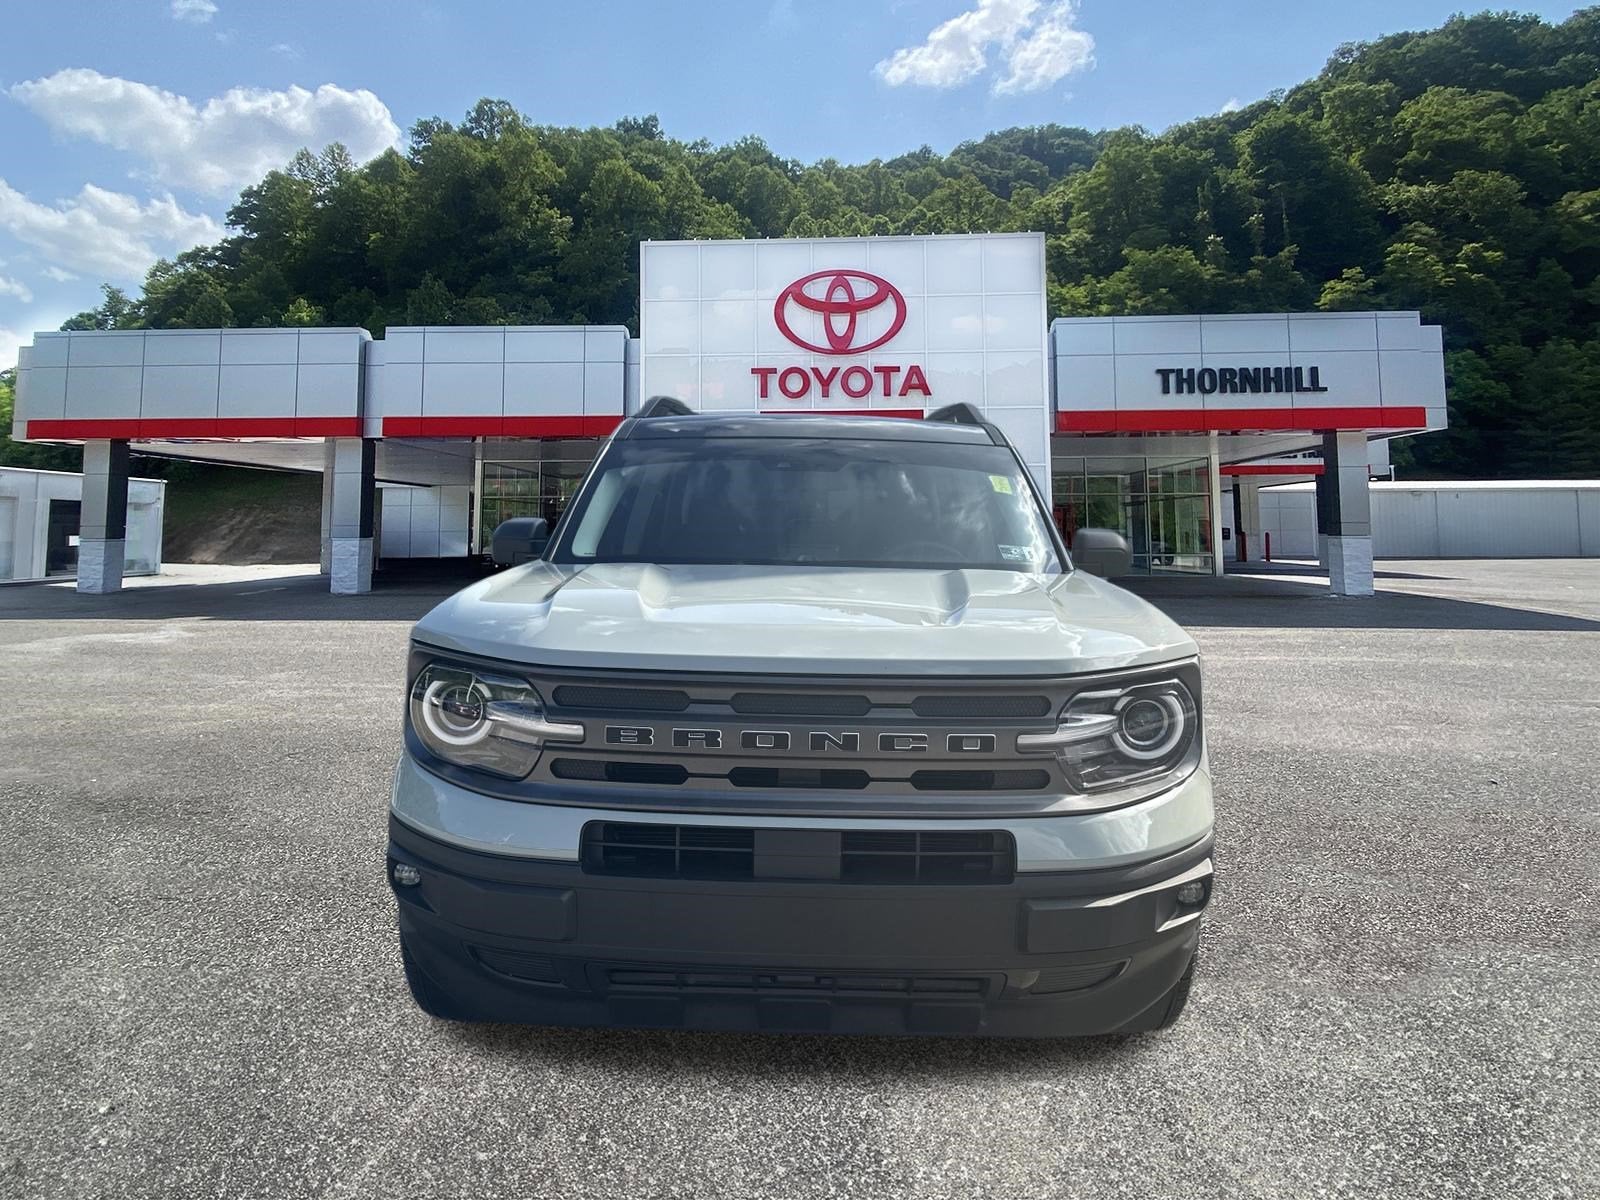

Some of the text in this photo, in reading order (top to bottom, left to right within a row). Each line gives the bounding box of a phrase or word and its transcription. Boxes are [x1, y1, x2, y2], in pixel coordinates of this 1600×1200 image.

[751, 365, 932, 399] TOYOTA
[1155, 366, 1328, 395] THORNHILL
[604, 724, 997, 753] BRONCO
